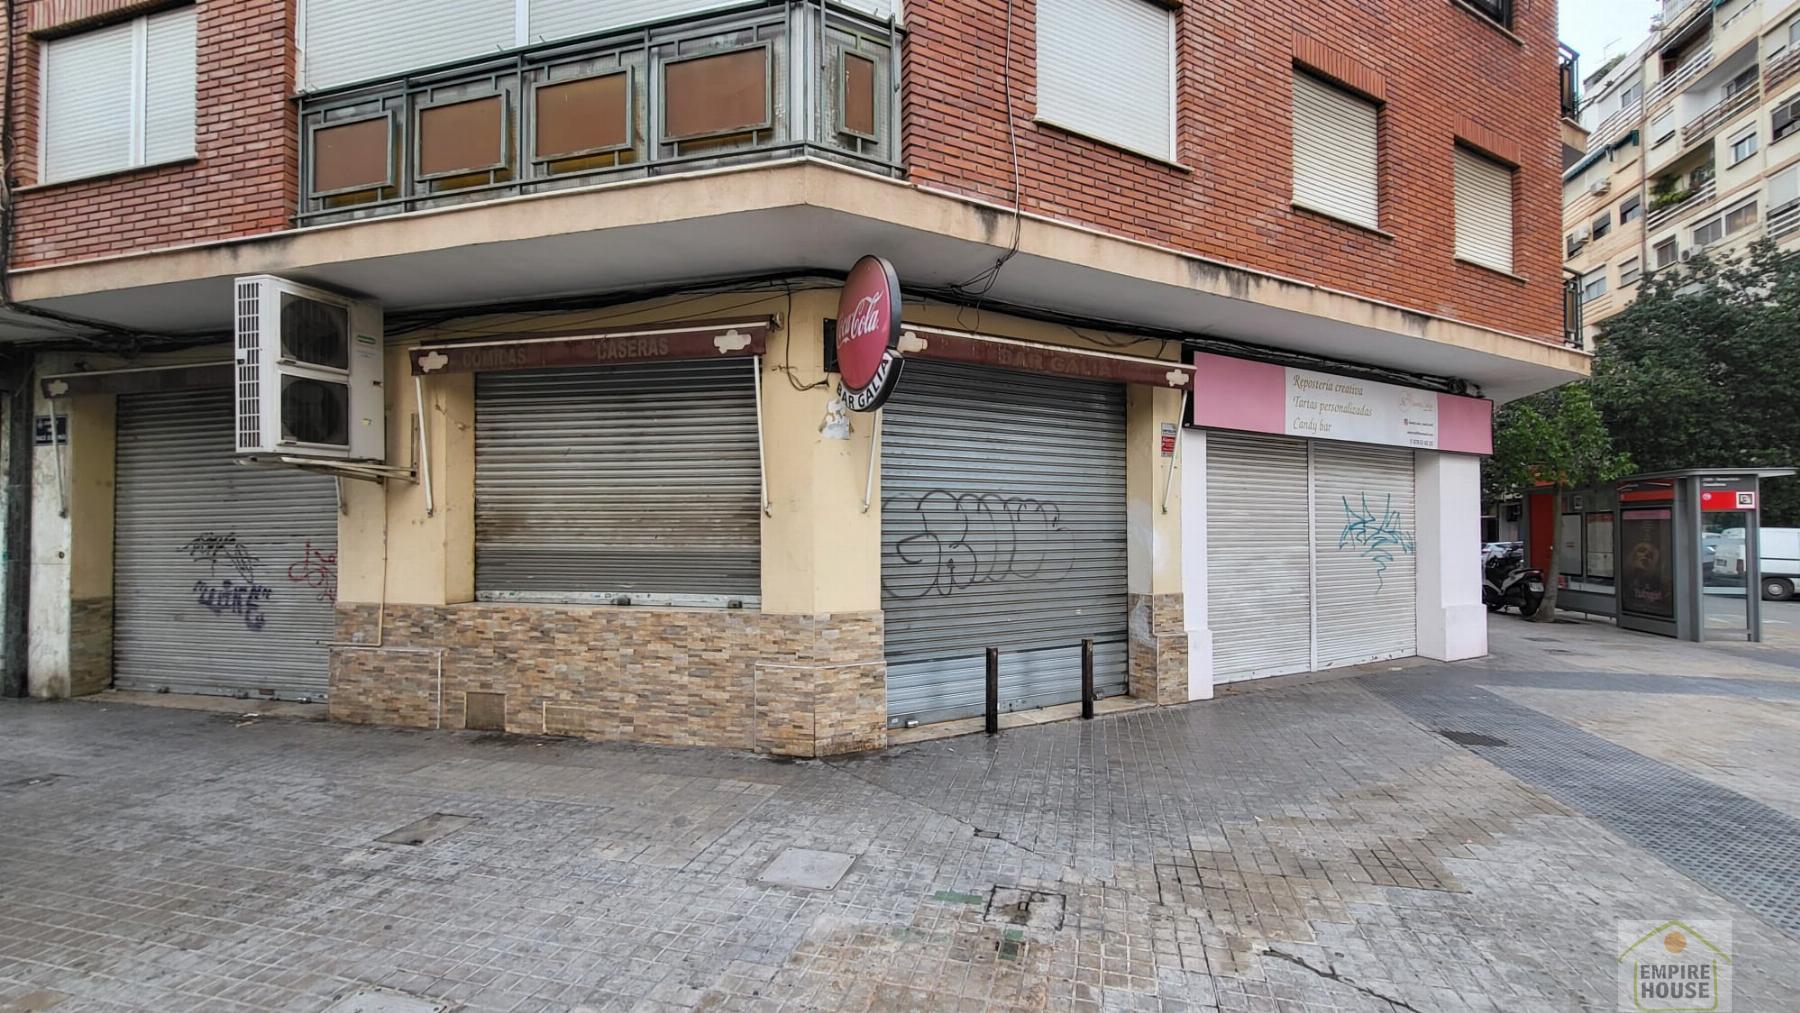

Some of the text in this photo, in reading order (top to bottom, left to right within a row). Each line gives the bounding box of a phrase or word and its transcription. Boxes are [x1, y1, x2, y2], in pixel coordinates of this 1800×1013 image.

[462, 337, 669, 369] COMIDAS CASERAS
[836, 358, 889, 408] BAR GALIA
[1293, 395, 1372, 417] Tartas personalizadas
[1293, 416, 1332, 434] Candy bar
